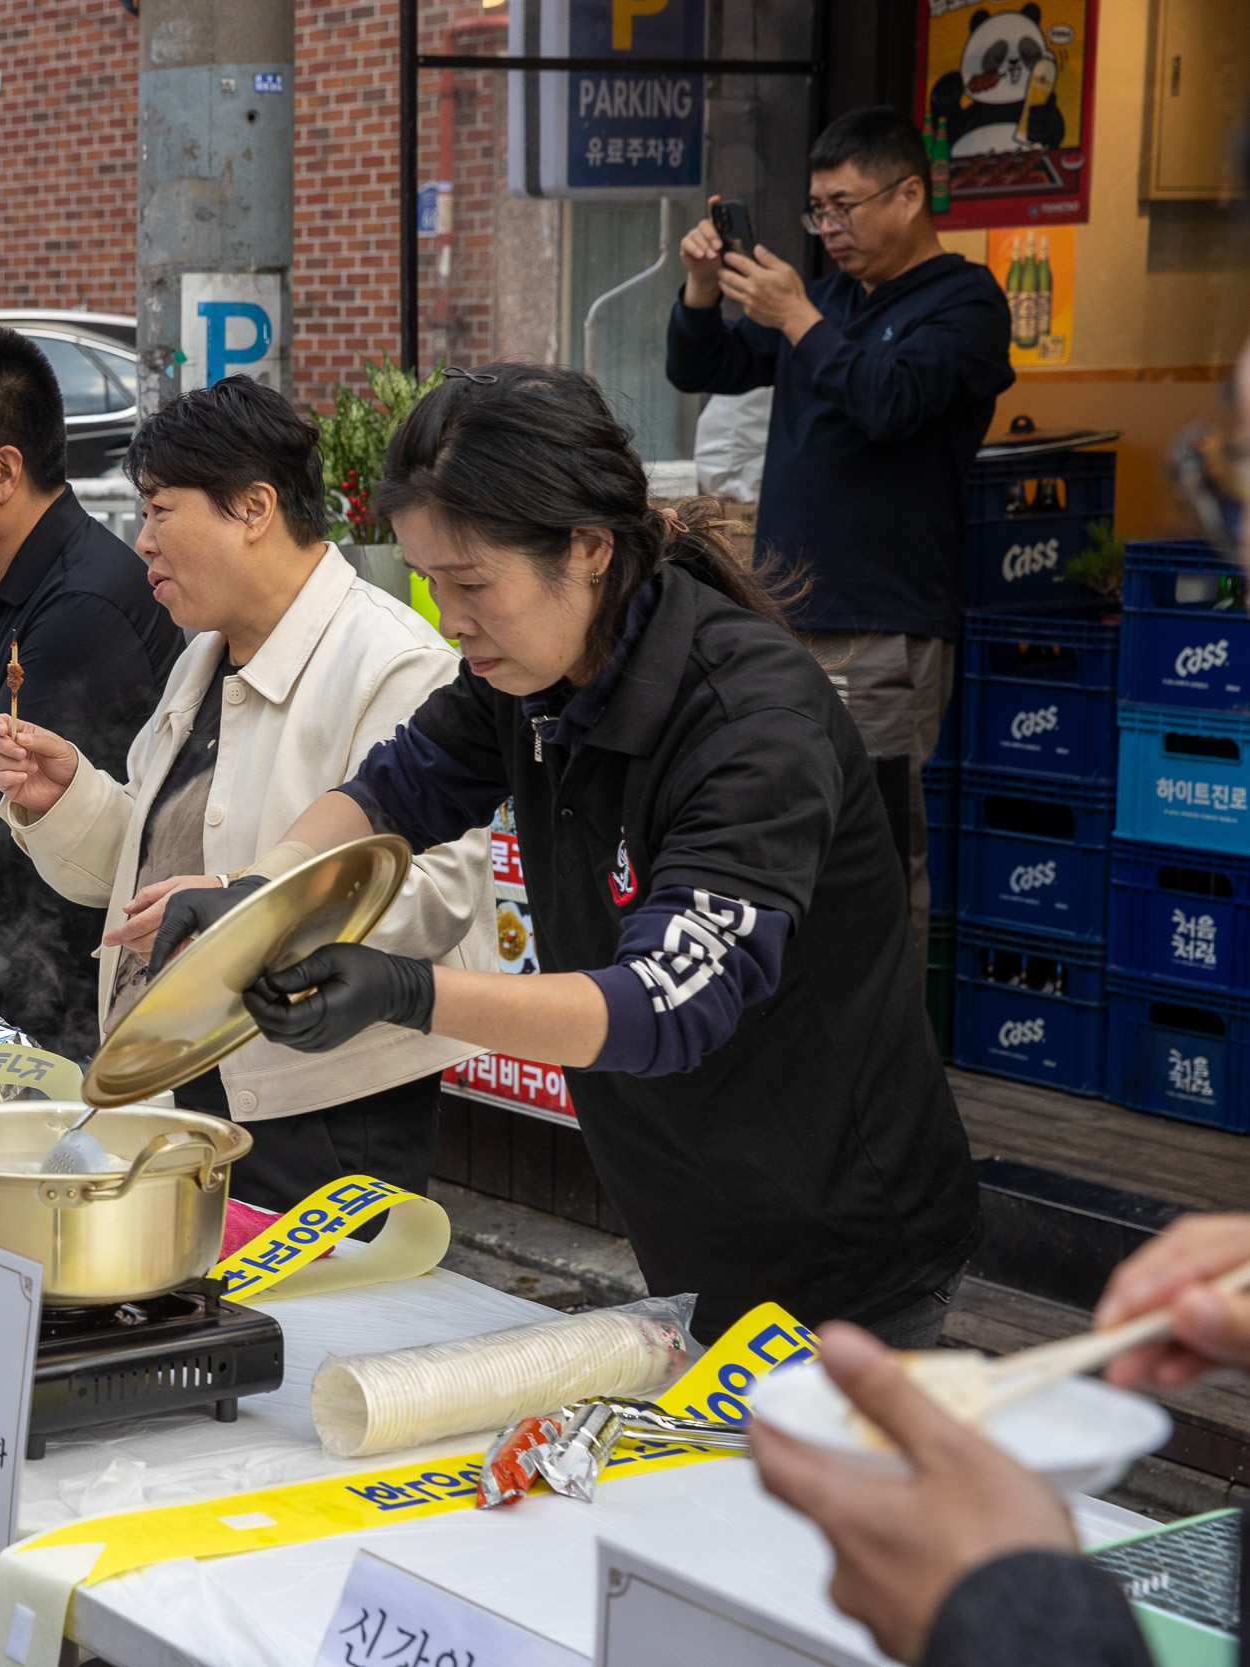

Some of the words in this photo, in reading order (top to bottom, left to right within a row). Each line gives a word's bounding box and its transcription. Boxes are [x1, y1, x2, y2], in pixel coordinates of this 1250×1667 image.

[579, 79, 692, 118] PARKING
[585, 137, 685, 167] 유료주차장
[197, 302, 273, 391] P
[1002, 538, 1059, 582] Cass
[1175, 639, 1229, 678] Cass
[1011, 705, 1058, 740] Cass
[1156, 777, 1247, 810] 하이트진로
[1009, 860, 1056, 893] Cass
[1171, 908, 1216, 940] 처음
[1171, 933, 1216, 965] 처럼
[998, 1017, 1045, 1047] Cass
